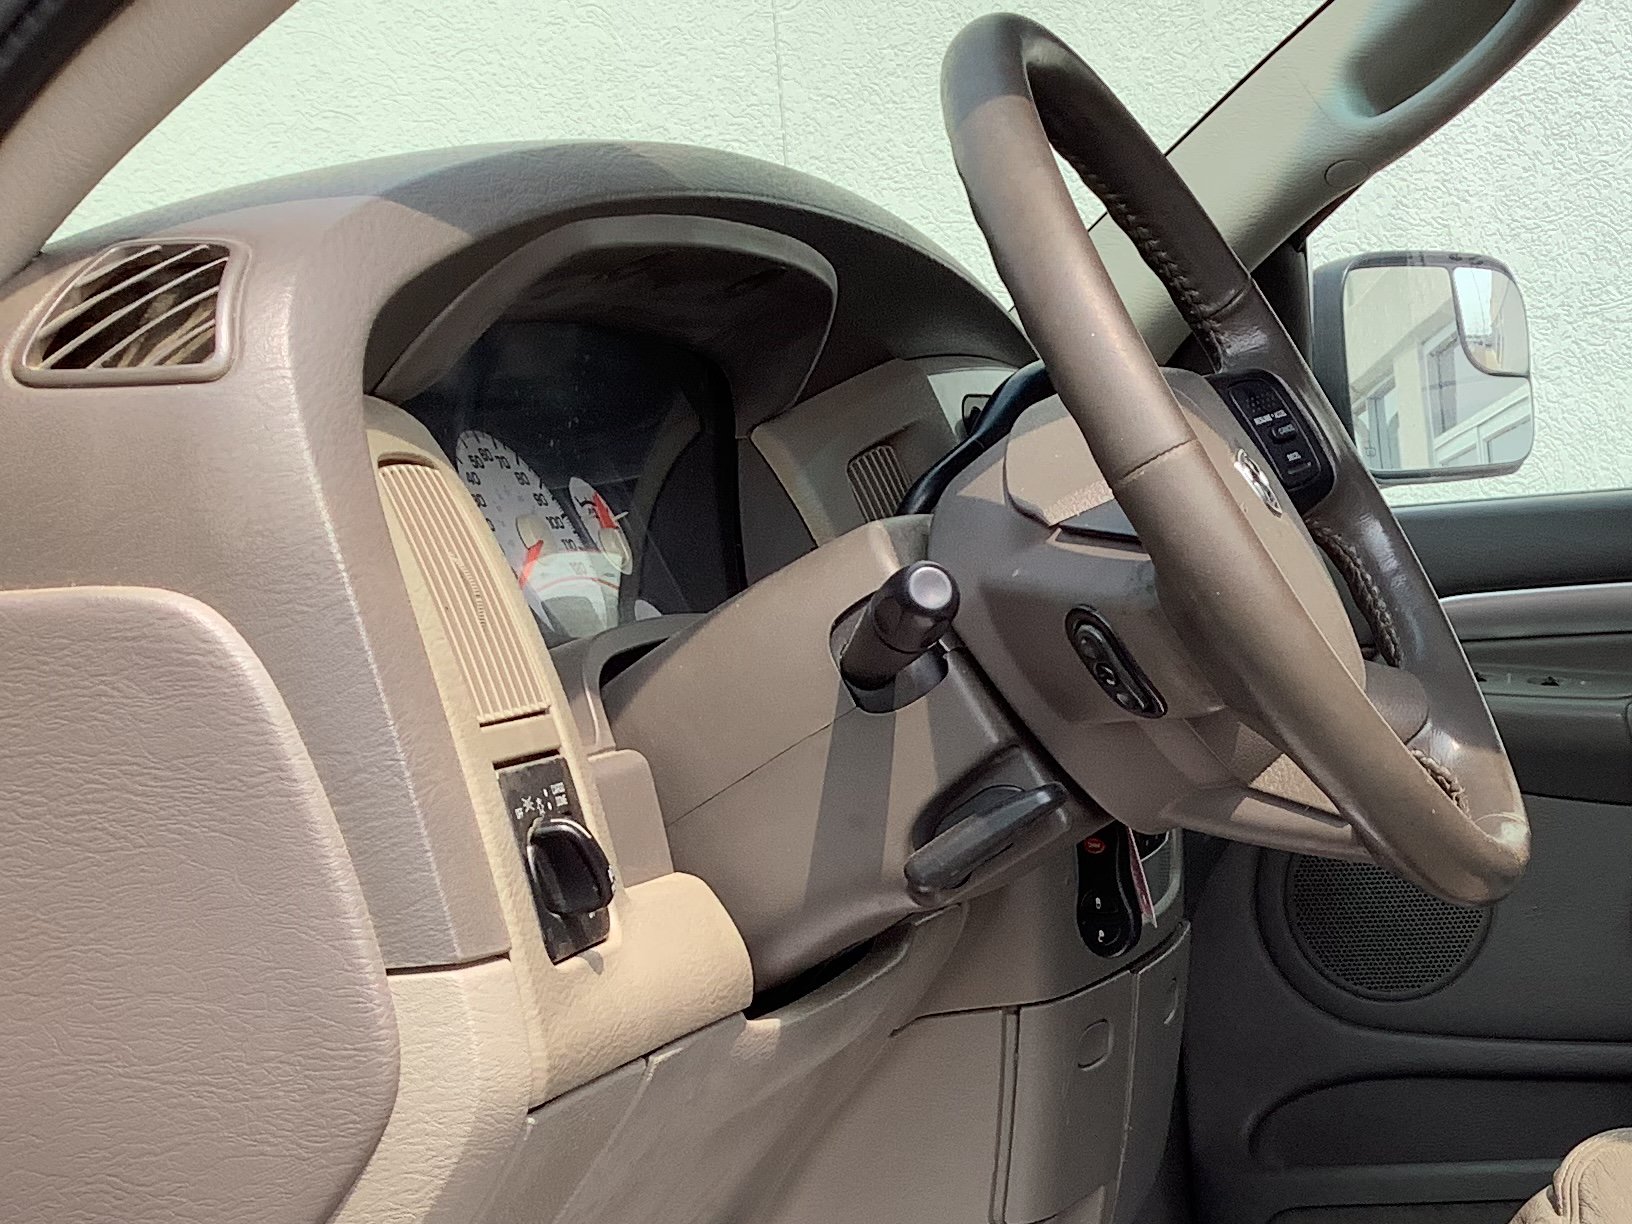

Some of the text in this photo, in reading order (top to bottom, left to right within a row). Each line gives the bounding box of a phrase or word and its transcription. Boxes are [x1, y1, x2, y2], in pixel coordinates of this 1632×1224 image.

[468, 455, 485, 469] 50
[495, 455, 510, 469] 70
[466, 472, 481, 485] 40
[546, 515, 565, 530] 100
